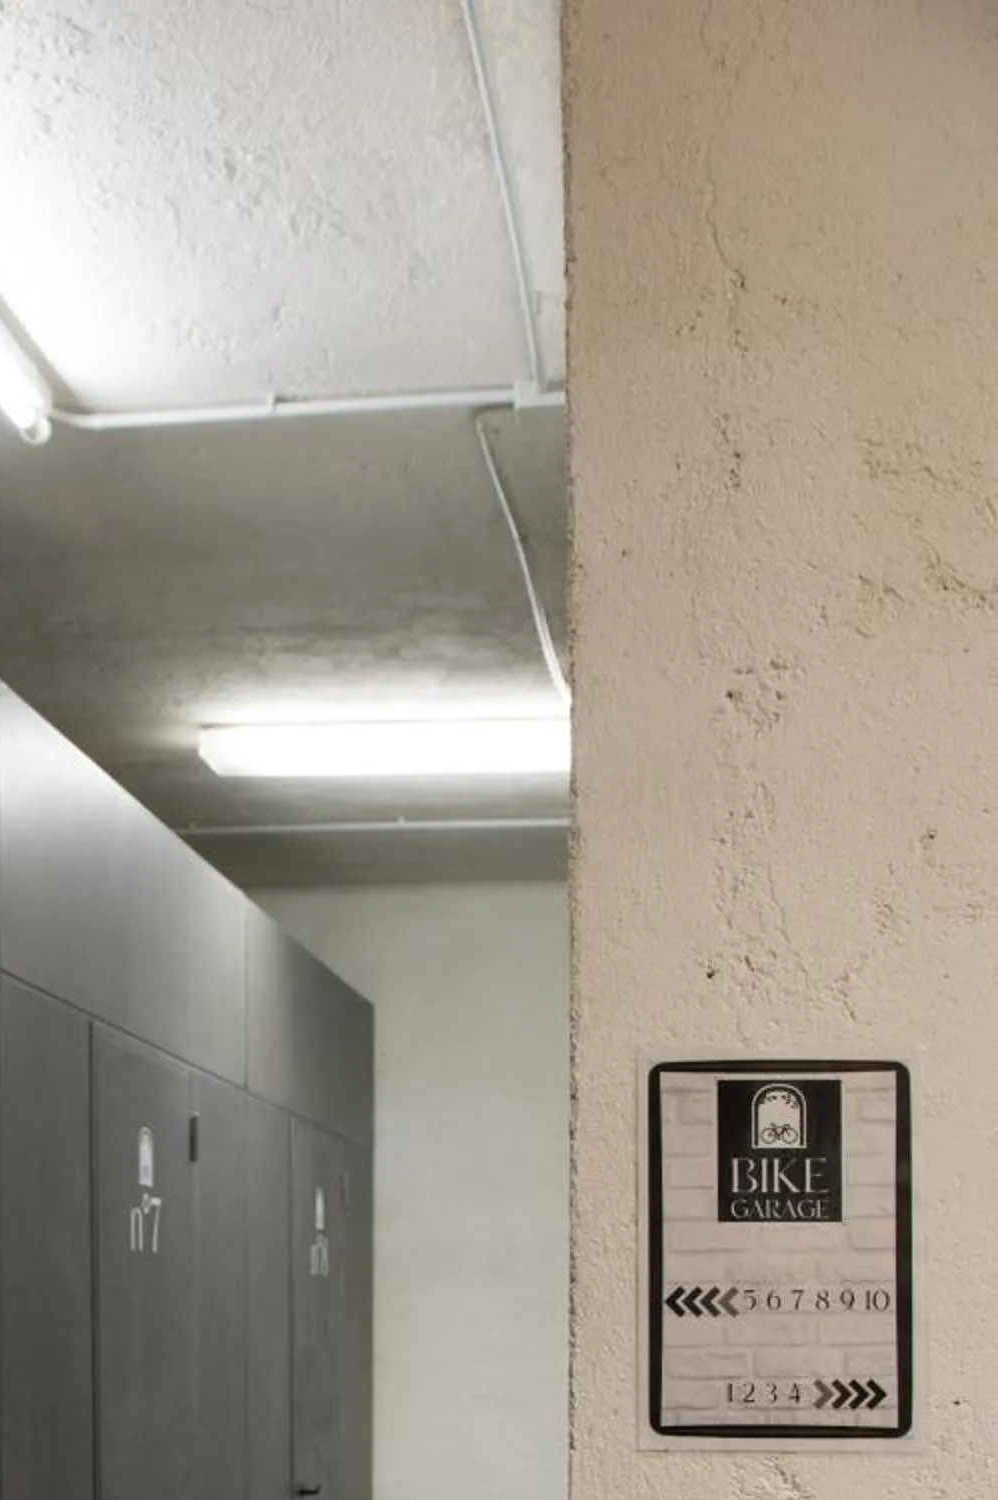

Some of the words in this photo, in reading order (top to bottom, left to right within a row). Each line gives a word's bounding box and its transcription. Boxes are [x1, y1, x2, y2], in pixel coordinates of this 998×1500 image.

[732, 1157, 829, 1193] BIKE
[730, 1199, 831, 1219] GARAGE
[743, 1289, 758, 1310] 5
[766, 1289, 782, 1311] 6
[791, 1289, 805, 1310] 7
[815, 1289, 831, 1311] 8
[840, 1289, 856, 1310] 9
[865, 1288, 891, 1311] 10
[726, 1383, 734, 1403] 1
[743, 1383, 756, 1403] 2
[766, 1383, 778, 1403] 3
[789, 1383, 801, 1404] 4
